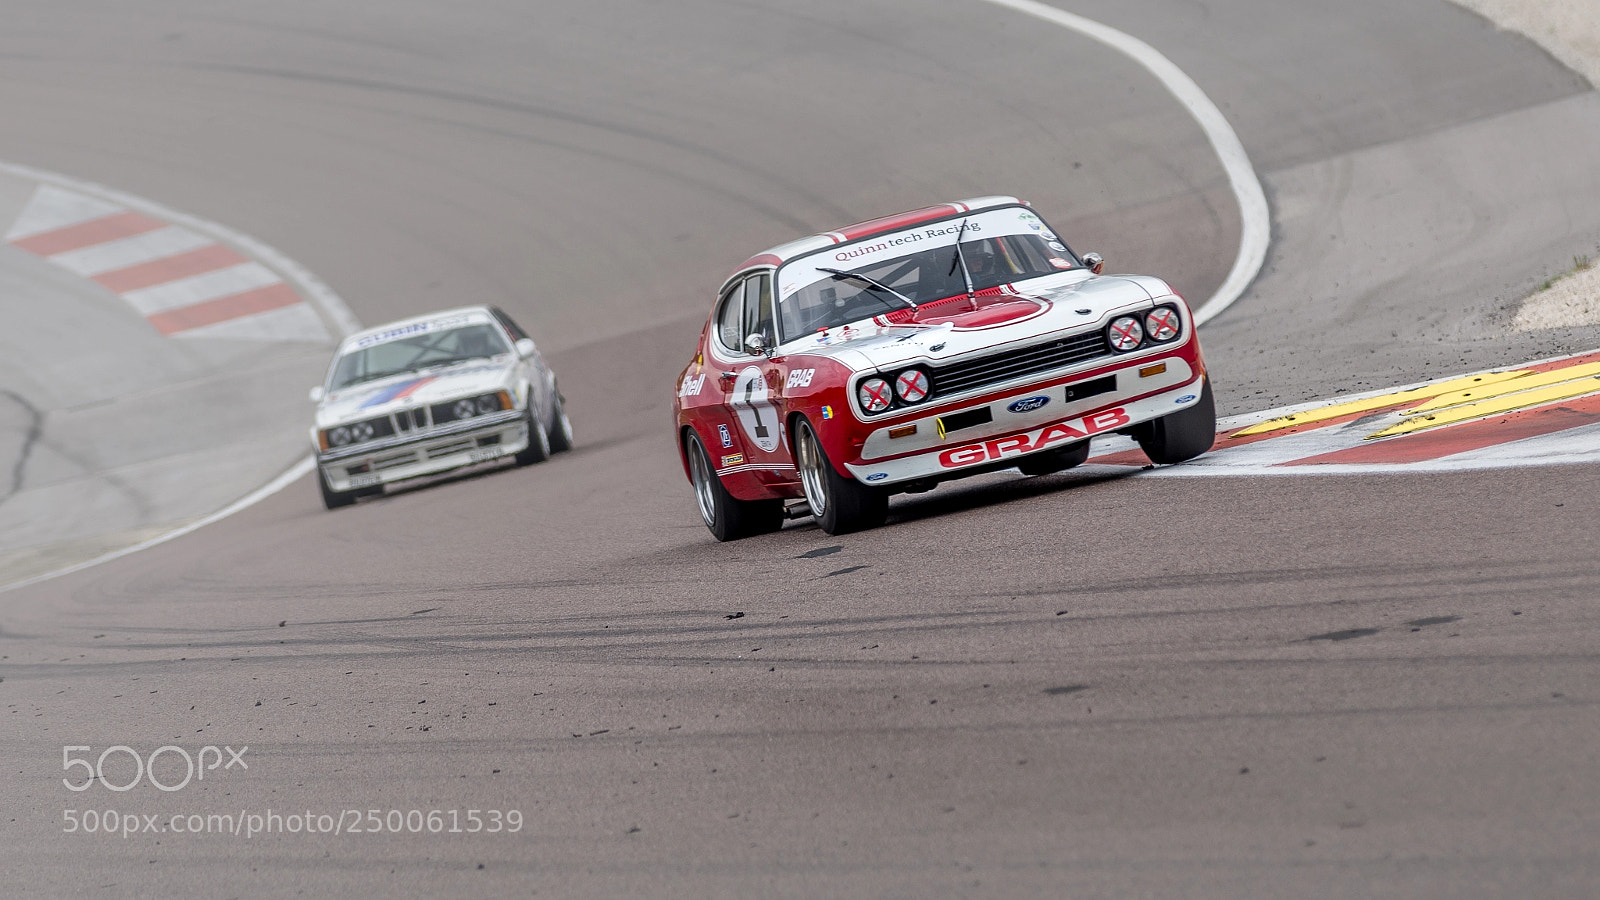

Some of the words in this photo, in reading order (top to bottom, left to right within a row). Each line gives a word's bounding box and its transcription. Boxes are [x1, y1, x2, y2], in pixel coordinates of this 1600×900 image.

[925, 222, 981, 239] Racing
[679, 373, 705, 397] Shell
[786, 369, 815, 388] GRAB
[744, 378, 769, 438] 1
[1015, 399, 1044, 411] Ford
[938, 407, 1130, 468] GRAB
